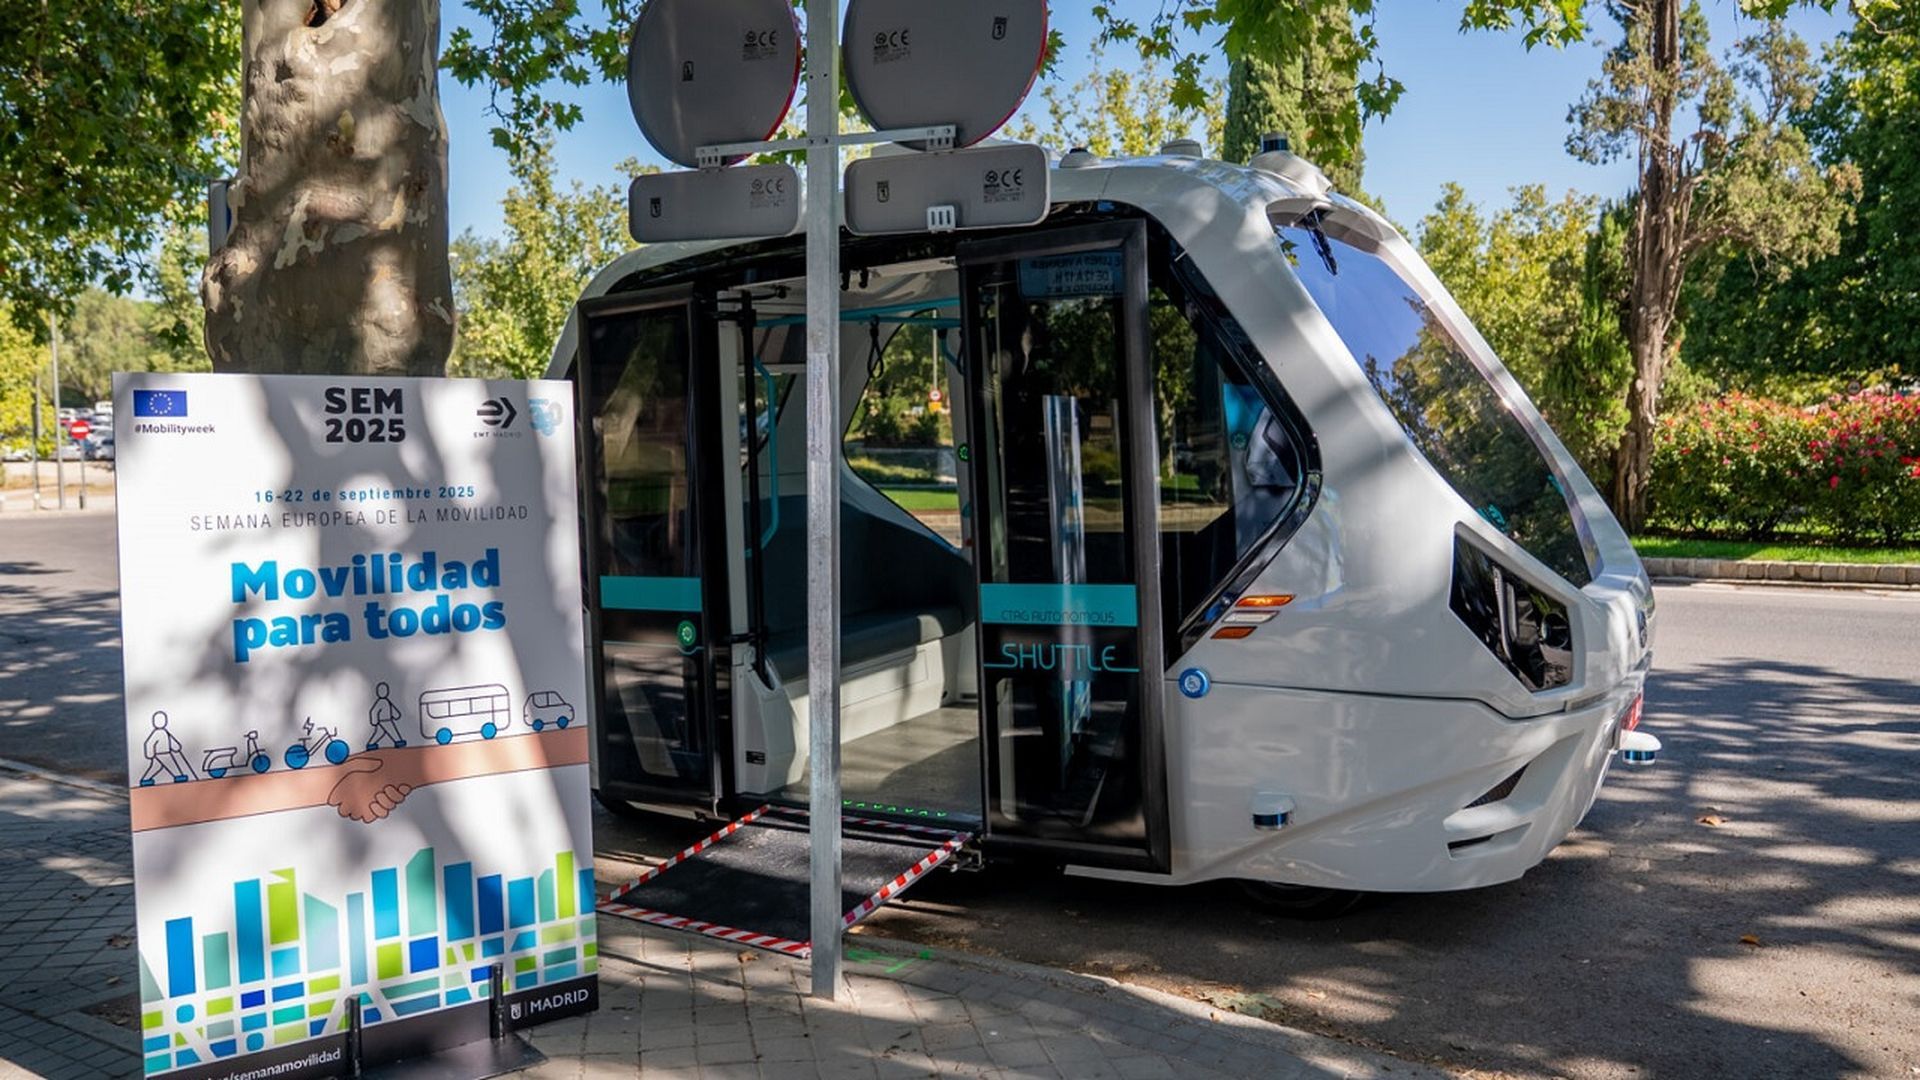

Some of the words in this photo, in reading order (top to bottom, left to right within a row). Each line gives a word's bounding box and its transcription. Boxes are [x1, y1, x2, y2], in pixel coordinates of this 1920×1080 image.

[325, 387, 404, 415] SEM
[134, 424, 216, 436] #Mobilityweek
[326, 418, 406, 443] 2025
[255, 489, 304, 503] 16-22
[312, 489, 331, 501] de
[339, 487, 431, 502] septiembre
[438, 486, 475, 499] 2025
[191, 514, 272, 532] SEMANA
[282, 511, 367, 528] EUROPEA
[375, 509, 397, 525] DE
[407, 509, 427, 523] LA
[436, 505, 528, 522] MOVILIDAD
[231, 548, 501, 603] Movilidad
[233, 611, 350, 663] para
[363, 594, 507, 640] todos
[1031, 610, 1115, 624] AUTONOMOUS
[999, 642, 1120, 672] SHUTTLE
[529, 989, 590, 1014] MADRID
